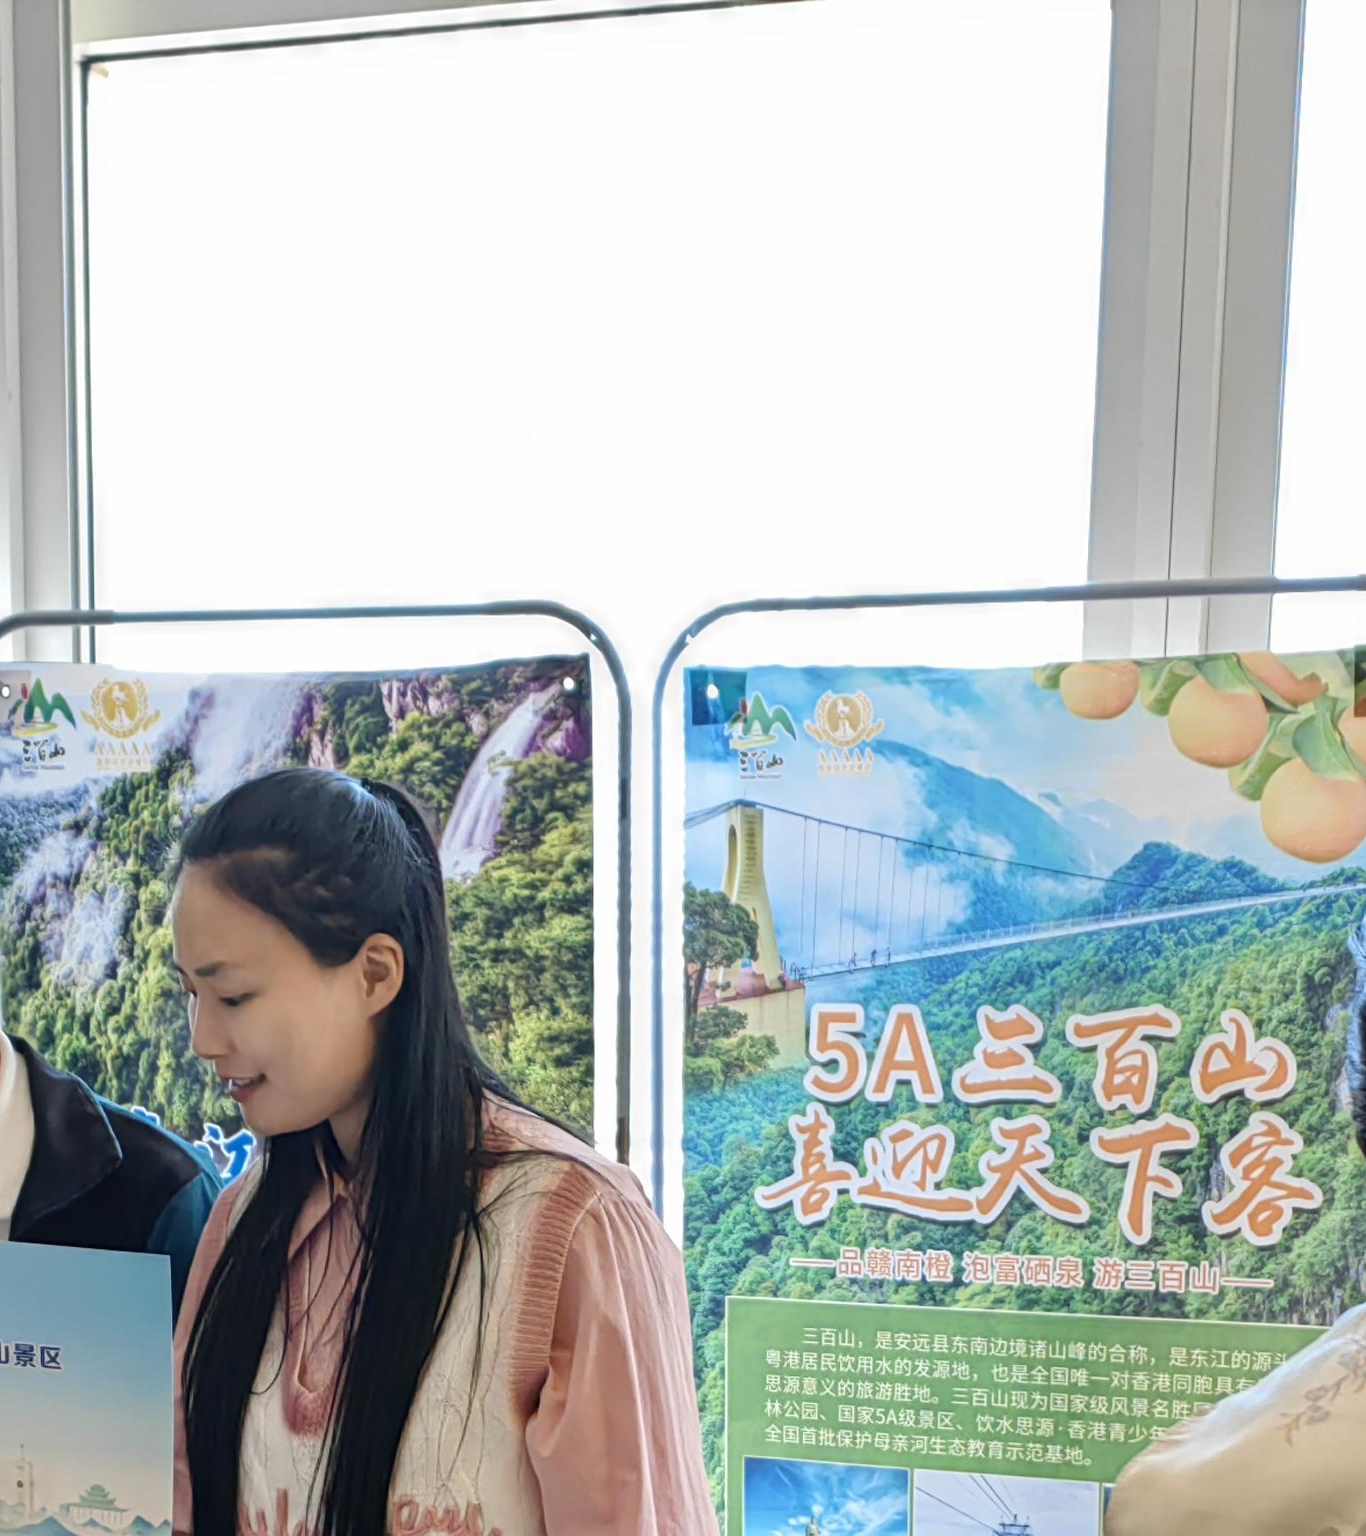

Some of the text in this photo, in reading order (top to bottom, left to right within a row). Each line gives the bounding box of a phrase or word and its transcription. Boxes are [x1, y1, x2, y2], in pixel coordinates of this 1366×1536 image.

[809, 1007, 1294, 1108] 5A三百山
[759, 1108, 1319, 1242] 喜迎天下客
[836, 1249, 1221, 1295] 品赣南橙 泡富硒泉 游三百山
